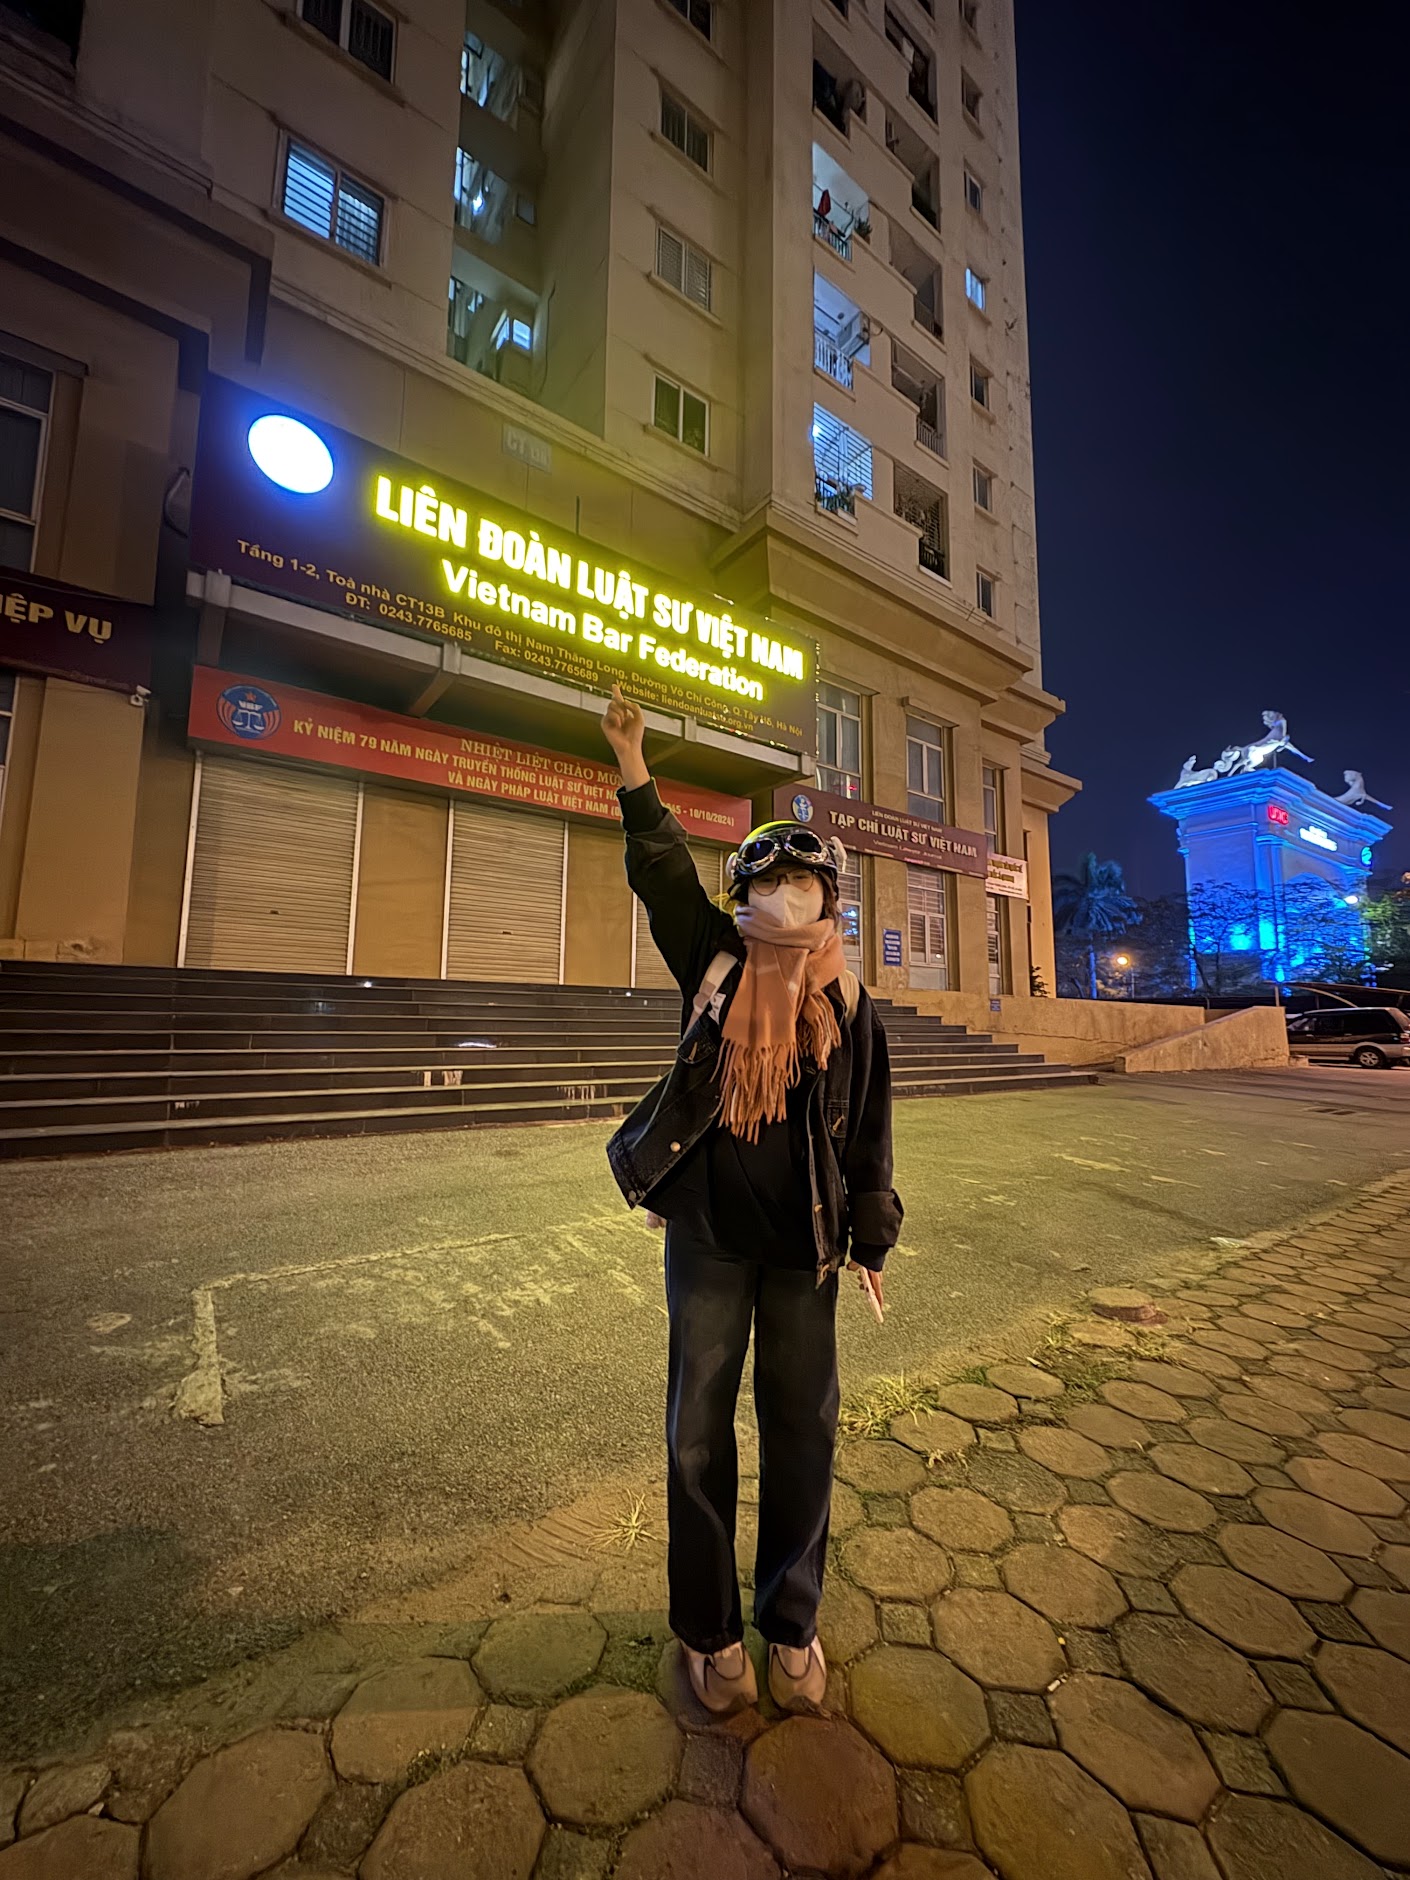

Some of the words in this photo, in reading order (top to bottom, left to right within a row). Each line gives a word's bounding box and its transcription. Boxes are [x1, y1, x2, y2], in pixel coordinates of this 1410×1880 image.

[376, 475, 467, 548] LIÊN
[478, 518, 571, 589] ĐOÀN
[577, 560, 649, 620] LUẬT
[653, 593, 694, 634] SƯ
[696, 608, 748, 659] VIỆT
[751, 633, 804, 680] NAM
[65, 610, 112, 644] VỤ
[290, 559, 320, 580] 1-2,
[325, 569, 356, 590] Toà
[361, 584, 391, 602] nhà
[396, 593, 445, 619] CT13B
[453, 612, 481, 630] Khu
[484, 625, 502, 637] đô
[505, 630, 523, 647] thị
[526, 637, 554, 655] Nam
[631, 672, 668, 694] Đường
[345, 591, 371, 611] ĐT:
[379, 602, 473, 642] 0243.7765685
[494, 639, 521, 658] Fax:
[524, 649, 599, 682] 0243.7765689
[442, 558, 576, 636] Vietnam
[582, 612, 633, 653] Bar
[638, 633, 764, 701] Federation
[293, 717, 314, 736] KỶ
[317, 725, 356, 745] NIỆM
[360, 734, 378, 749] 79
[380, 739, 412, 757] NĂM
[415, 745, 449, 765] NGÀY
[500, 766, 536, 784] THỐNG
[539, 774, 565, 791] LUẬT
[567, 781, 581, 793] SƯ
[583, 784, 604, 799] VIỆT
[605, 789, 619, 801] NA
[447, 770, 463, 785] VÀ
[466, 774, 498, 792] NGÀY
[501, 782, 531, 798] PHÁP
[533, 789, 560, 805] LUẬT
[561, 793, 583, 810] VIỆT
[585, 800, 609, 815] NAM
[689, 808, 735, 827] 10/10/2024)
[460, 738, 513, 762] NHIỆT
[515, 751, 552, 771] LIỆT
[553, 758, 594, 780] CHÀO
[597, 771, 624, 787] MỪN
[829, 810, 855, 829] TẠP
[858, 819, 879, 834] CHÍ
[881, 823, 909, 842] LUẬT
[911, 831, 928, 845] SƯ
[929, 835, 952, 852] VIỆT
[953, 842, 978, 858] NAM
